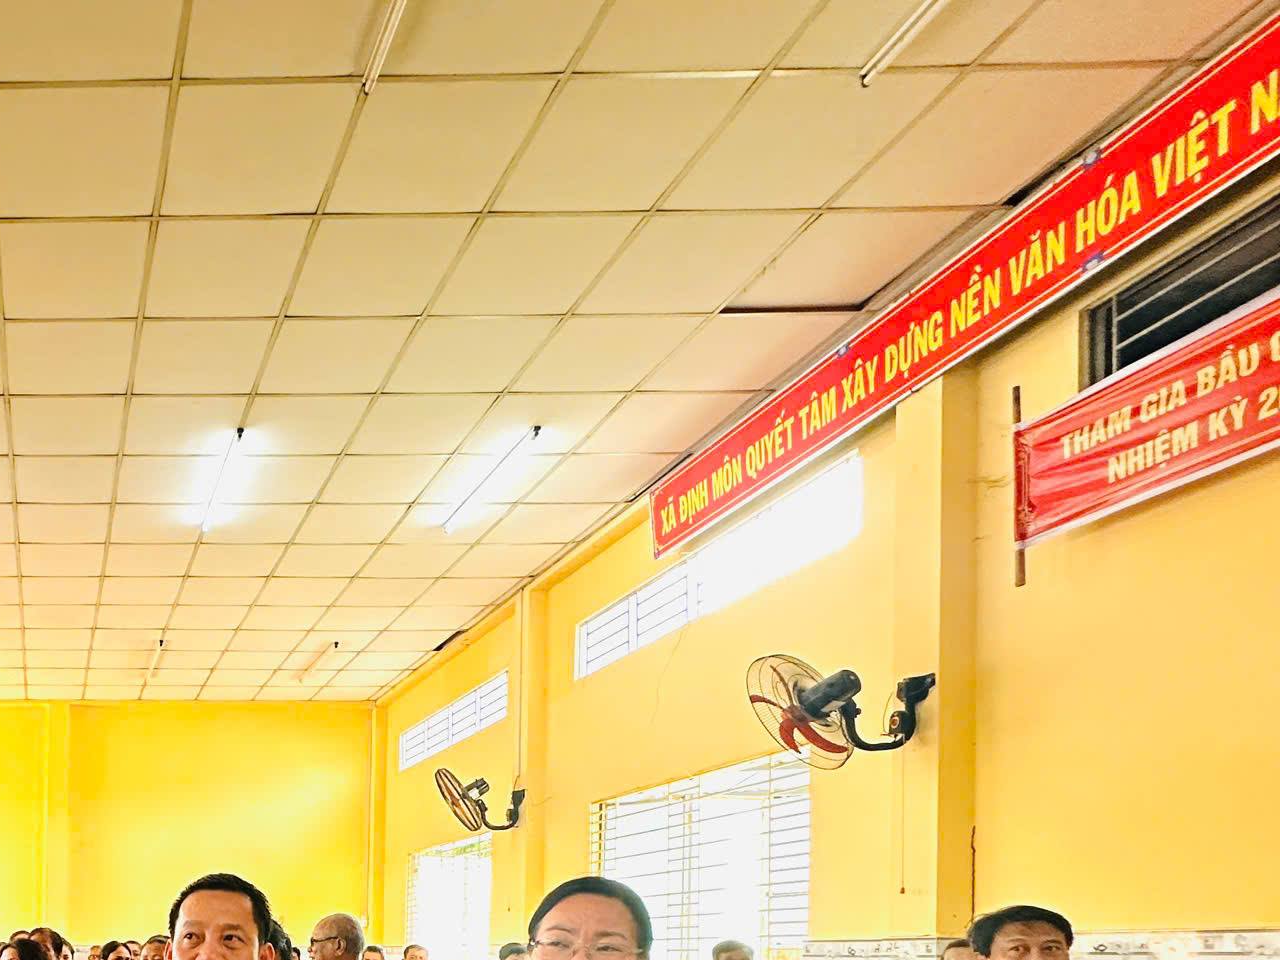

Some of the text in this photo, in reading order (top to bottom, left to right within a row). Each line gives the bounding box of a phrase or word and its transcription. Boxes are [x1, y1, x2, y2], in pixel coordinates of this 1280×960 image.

[660, 496, 677, 536] XÃ
[679, 478, 709, 524] ĐỊNH
[712, 453, 742, 500] MÔN
[745, 410, 795, 480] QUYẾT
[799, 382, 837, 440] TÂM
[841, 355, 879, 414] XÂY
[884, 312, 944, 383] DỰNG
[950, 265, 1001, 338] NỀN
[1008, 222, 1066, 296] VĂN
[1075, 170, 1141, 253] HÓA
[1151, 100, 1237, 198] VIỆT
[1060, 405, 1133, 459] THAM
[1140, 380, 1187, 423] GIA
[1196, 343, 1260, 398] BẦU
[1107, 420, 1199, 484] NHIỆM
